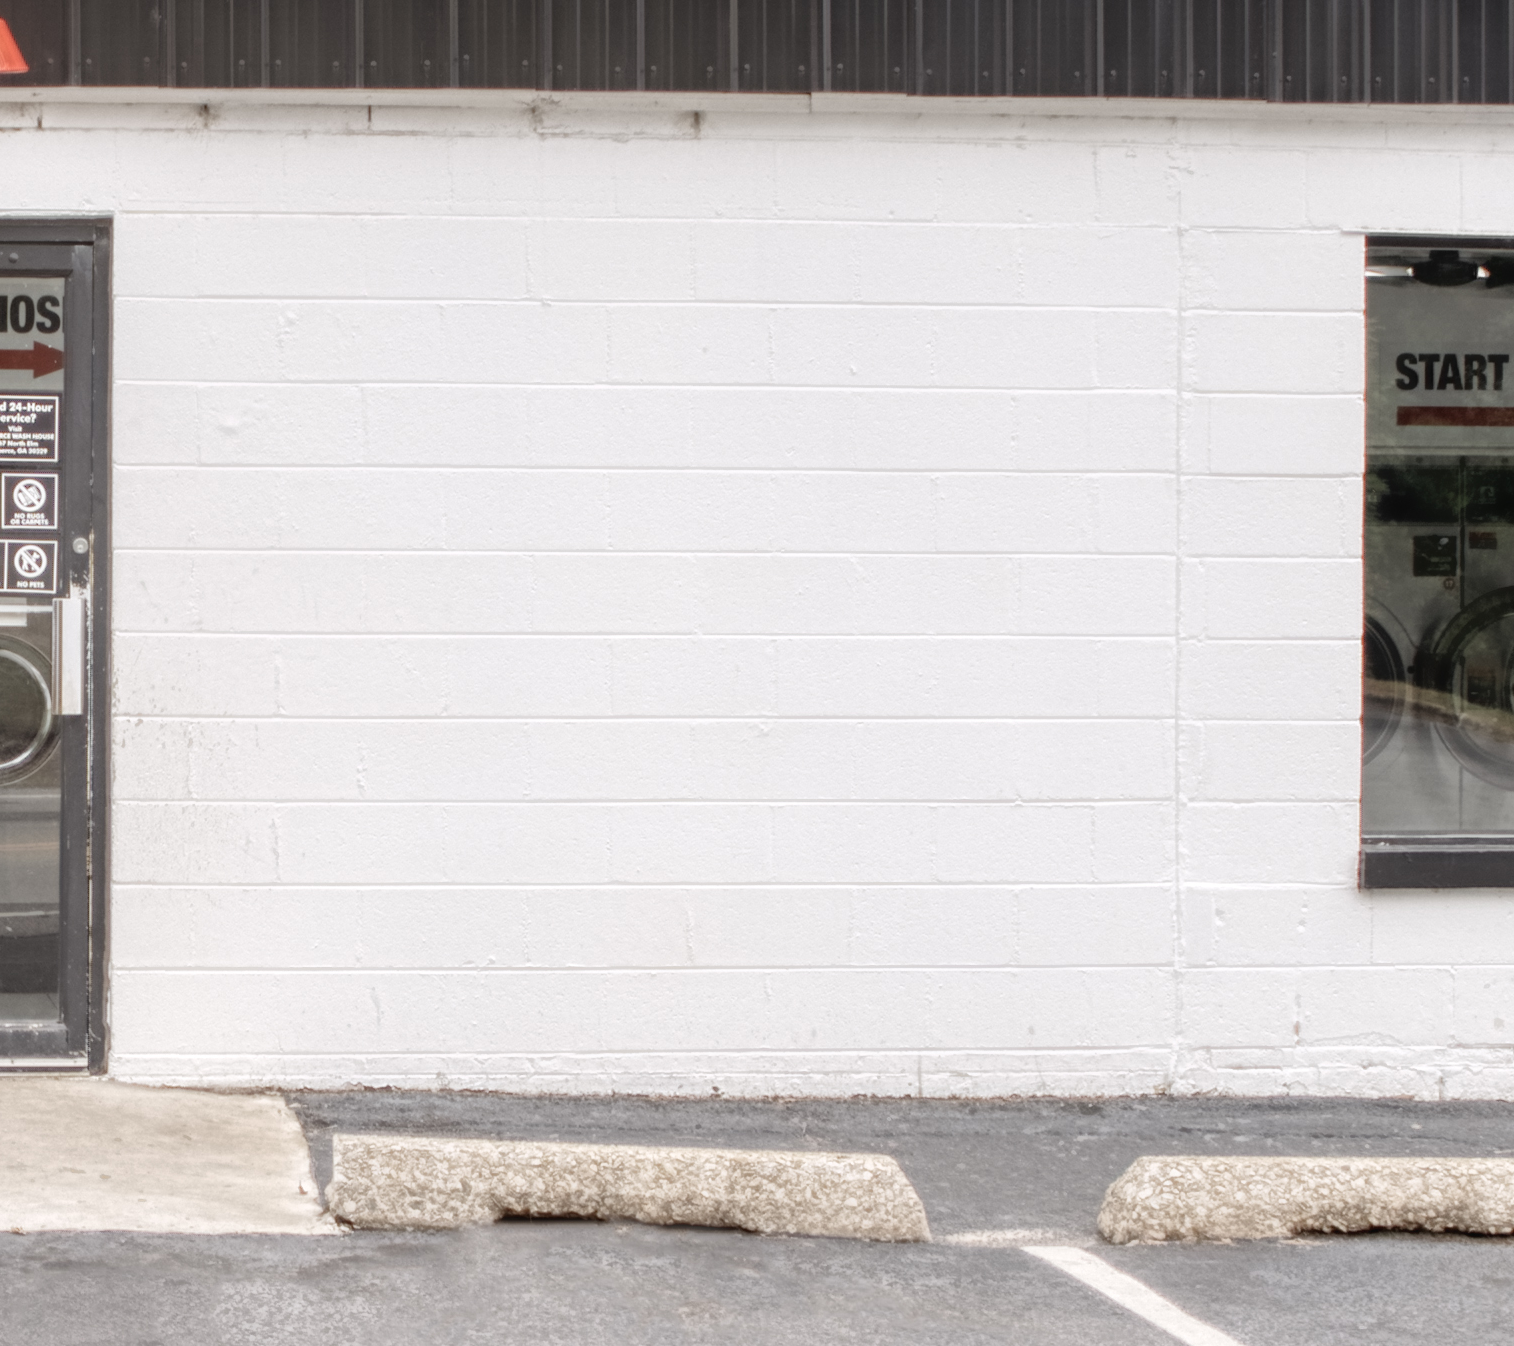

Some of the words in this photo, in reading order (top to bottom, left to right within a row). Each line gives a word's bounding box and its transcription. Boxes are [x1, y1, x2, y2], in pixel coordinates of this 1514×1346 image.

[1394, 353, 1510, 391] START
[9, 402, 54, 413] 24-Hour
[8, 425, 23, 433] Visit
[12, 432, 31, 440] WASH
[32, 433, 55, 441] HOUSE
[16, 580, 28, 588] NO
[29, 581, 45, 589] PETS
